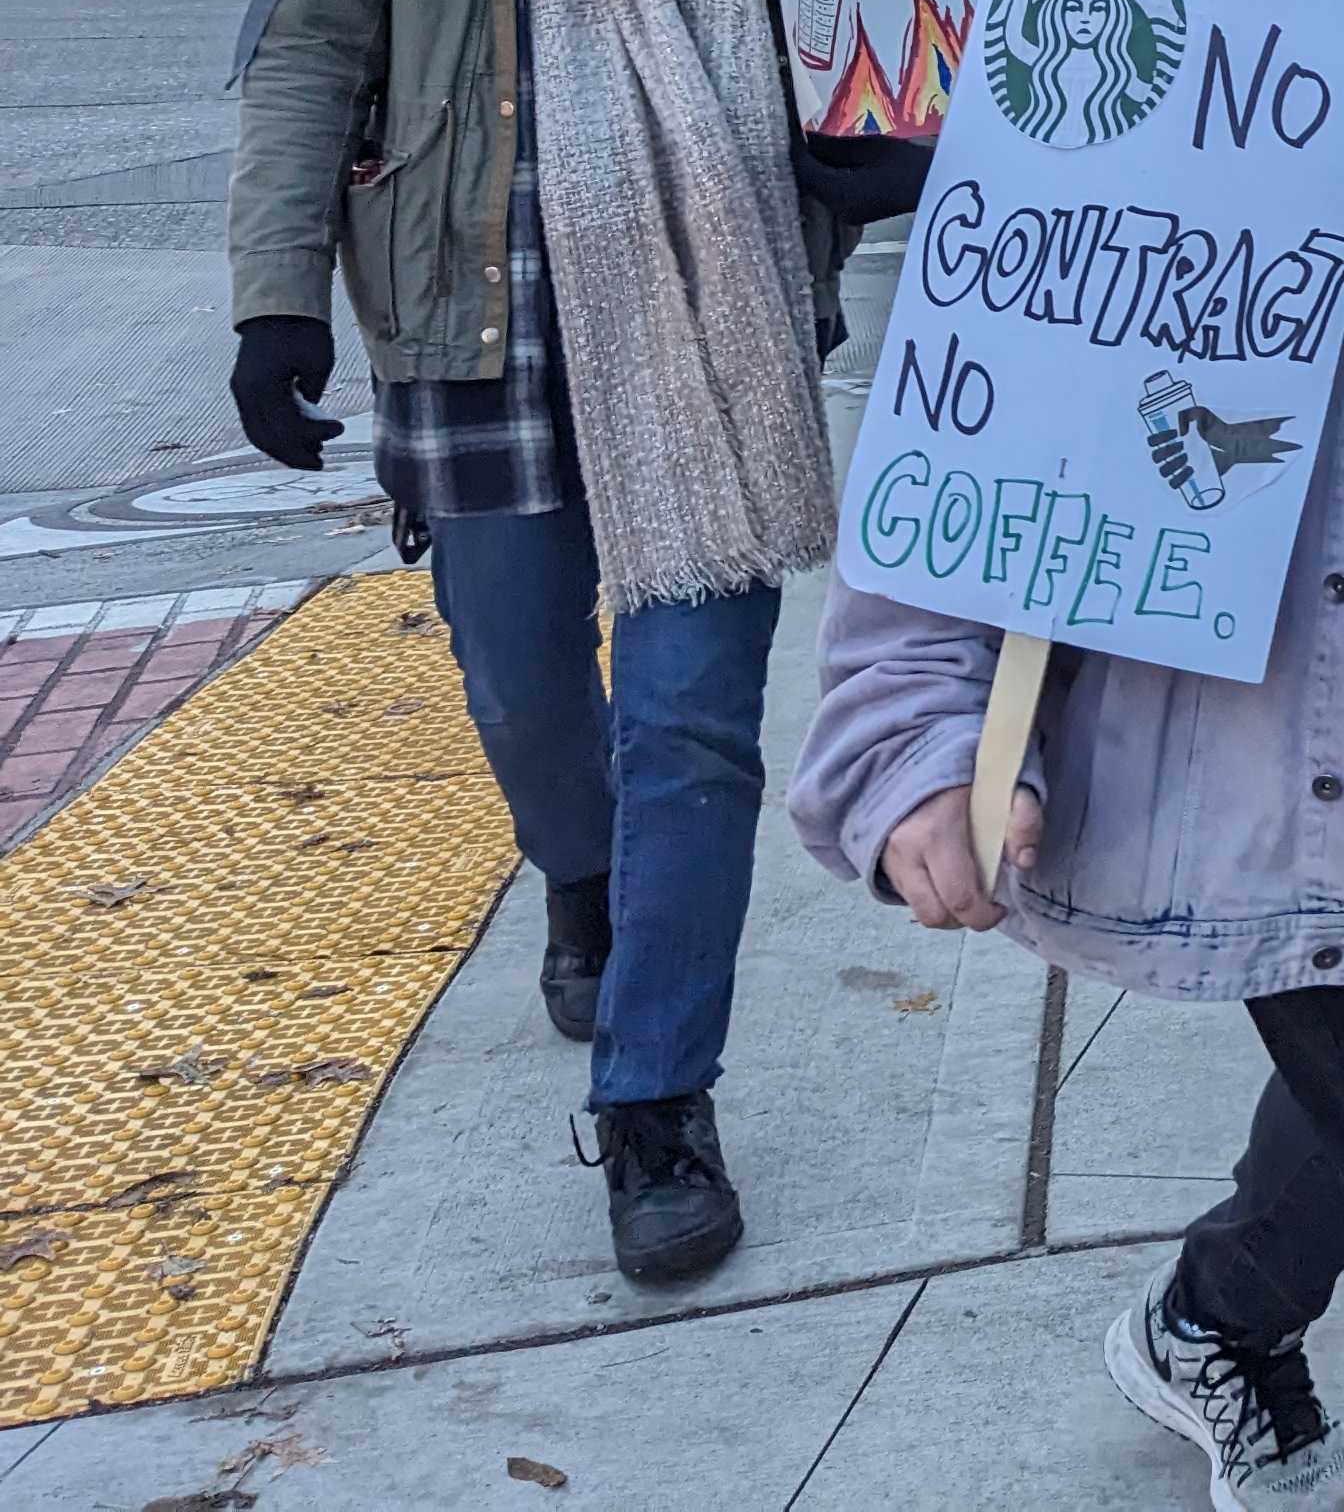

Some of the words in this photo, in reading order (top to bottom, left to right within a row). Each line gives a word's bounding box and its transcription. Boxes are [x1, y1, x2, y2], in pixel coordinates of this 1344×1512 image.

[1193, 22, 1332, 150] NO
[893, 333, 995, 436] NO
[861, 449, 1237, 641] COFFEE.
